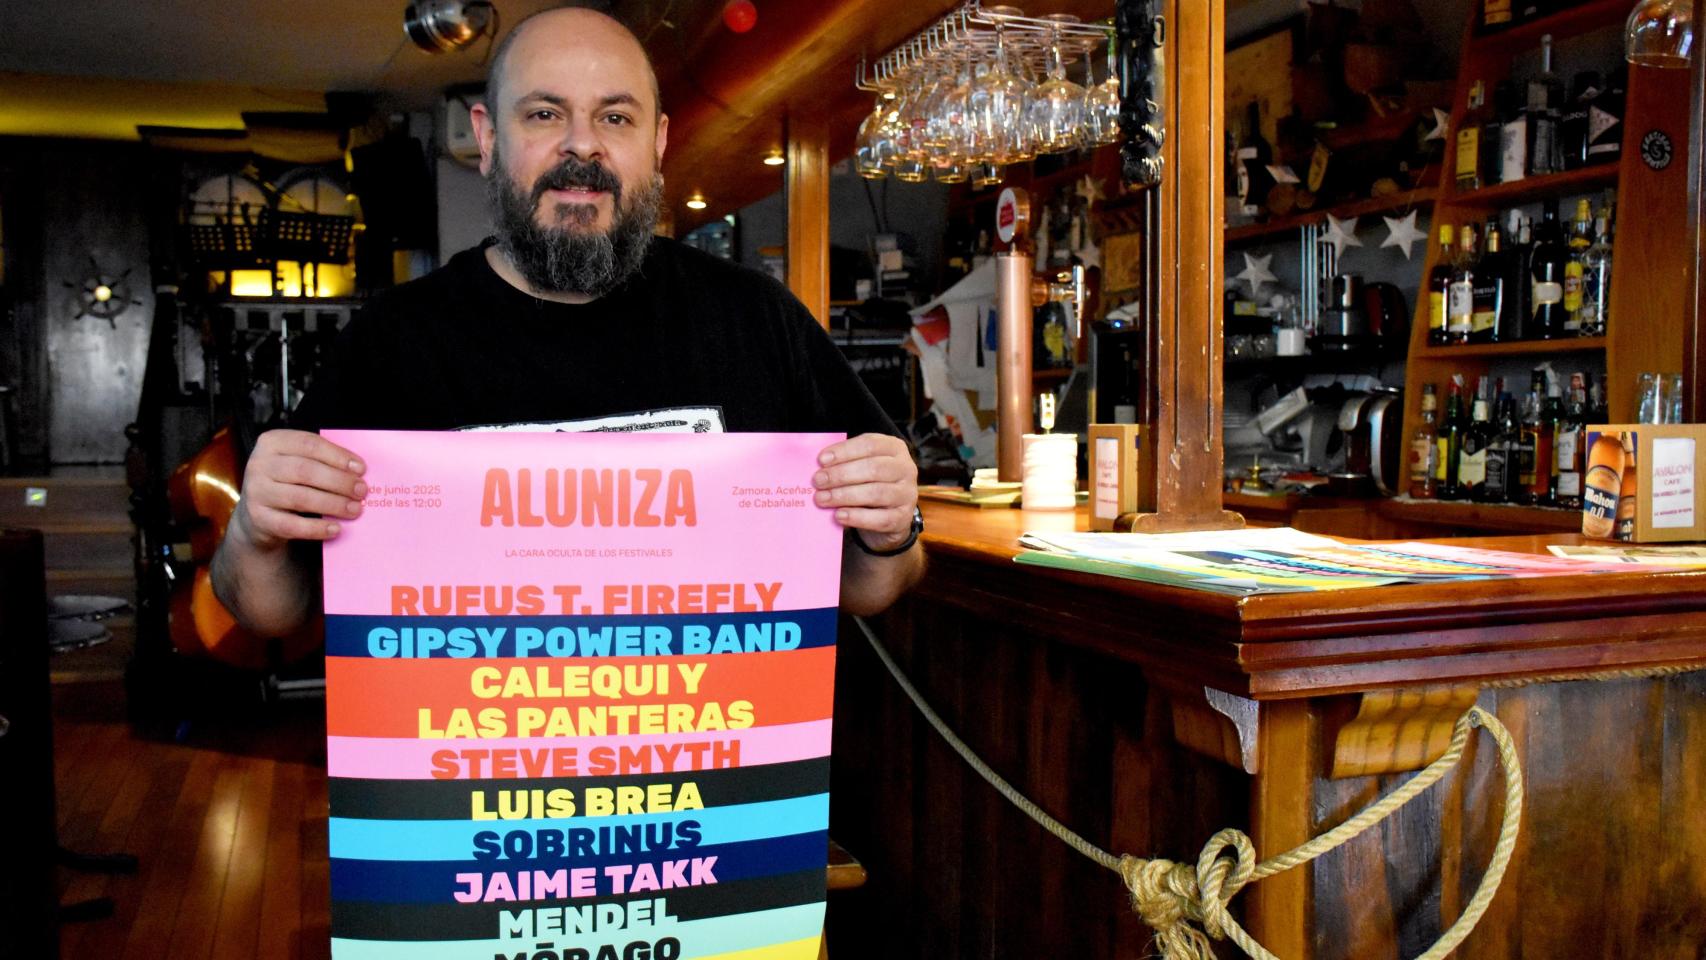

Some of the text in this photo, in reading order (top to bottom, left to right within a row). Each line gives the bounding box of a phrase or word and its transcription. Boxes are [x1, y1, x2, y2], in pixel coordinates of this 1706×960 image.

[1654, 463, 1692, 478] AVALON
[368, 485, 441, 496] de junio 2025
[395, 498, 410, 508] las
[413, 498, 442, 508] 12:00
[481, 468, 696, 528] ALUNIZA
[732, 486, 813, 497] Zamora, Aceñas
[739, 498, 805, 508] de Cabañales
[504, 548, 673, 558] LA CARA OCULTA DE LOS FESTIVALES
[391, 582, 783, 616] RUFUS T. FIREFLY
[367, 621, 802, 658] GIPSY POWER BAND
[470, 662, 708, 699] CALEQUI Y
[418, 700, 755, 739] LAS PANTERAS
[431, 739, 741, 780] STEVE SMYTH
[472, 782, 704, 820] LUIS BREA
[473, 820, 702, 860] SOBRINUS
[454, 856, 718, 903] JAIME TAKK
[499, 897, 679, 939] MENDEL
[494, 937, 681, 960] AGO
